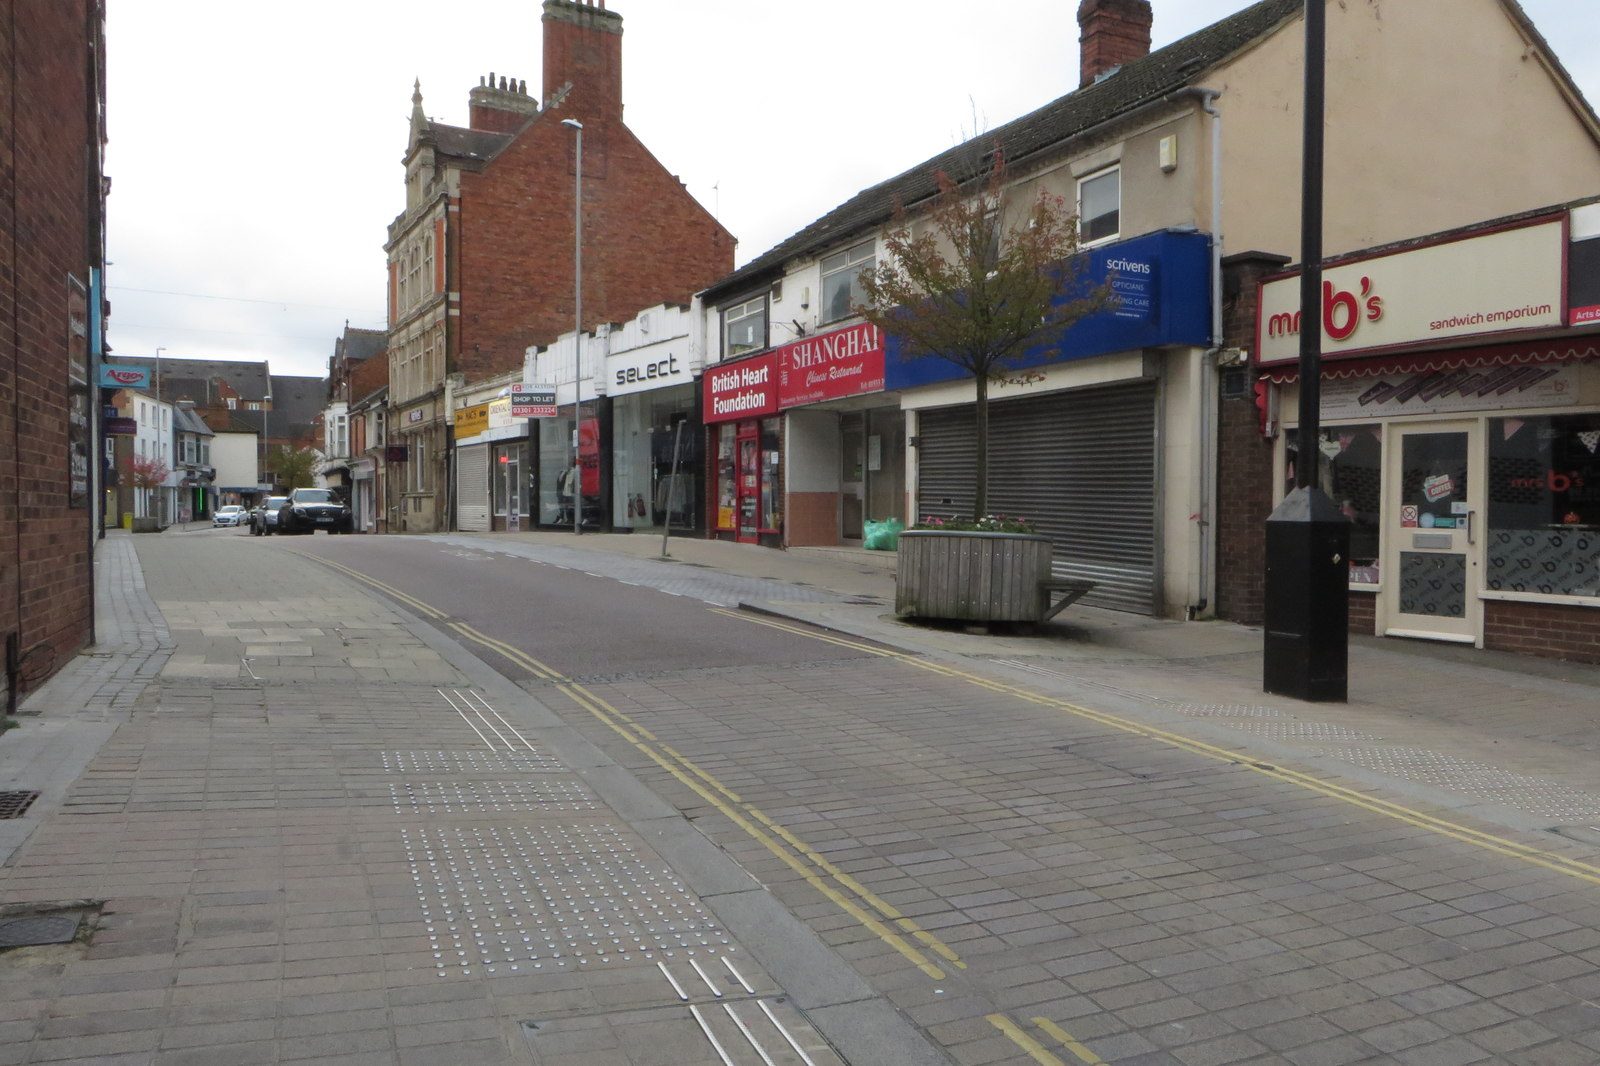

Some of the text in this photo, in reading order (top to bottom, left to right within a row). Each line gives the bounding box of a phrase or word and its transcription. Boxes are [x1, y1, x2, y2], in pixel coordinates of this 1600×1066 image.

[1106, 257, 1150, 274] scrivens
[1111, 280, 1145, 291] OPTICIANS
[1429, 304, 1552, 331] sandwich emporium
[1576, 311, 1593, 320] Arts
[792, 324, 879, 370] SHANGHAI
[105, 369, 145, 381] Argos
[712, 364, 768, 394] British Heart
[805, 361, 864, 388] Chinese Restaurant
[713, 389, 766, 415] Foundation
